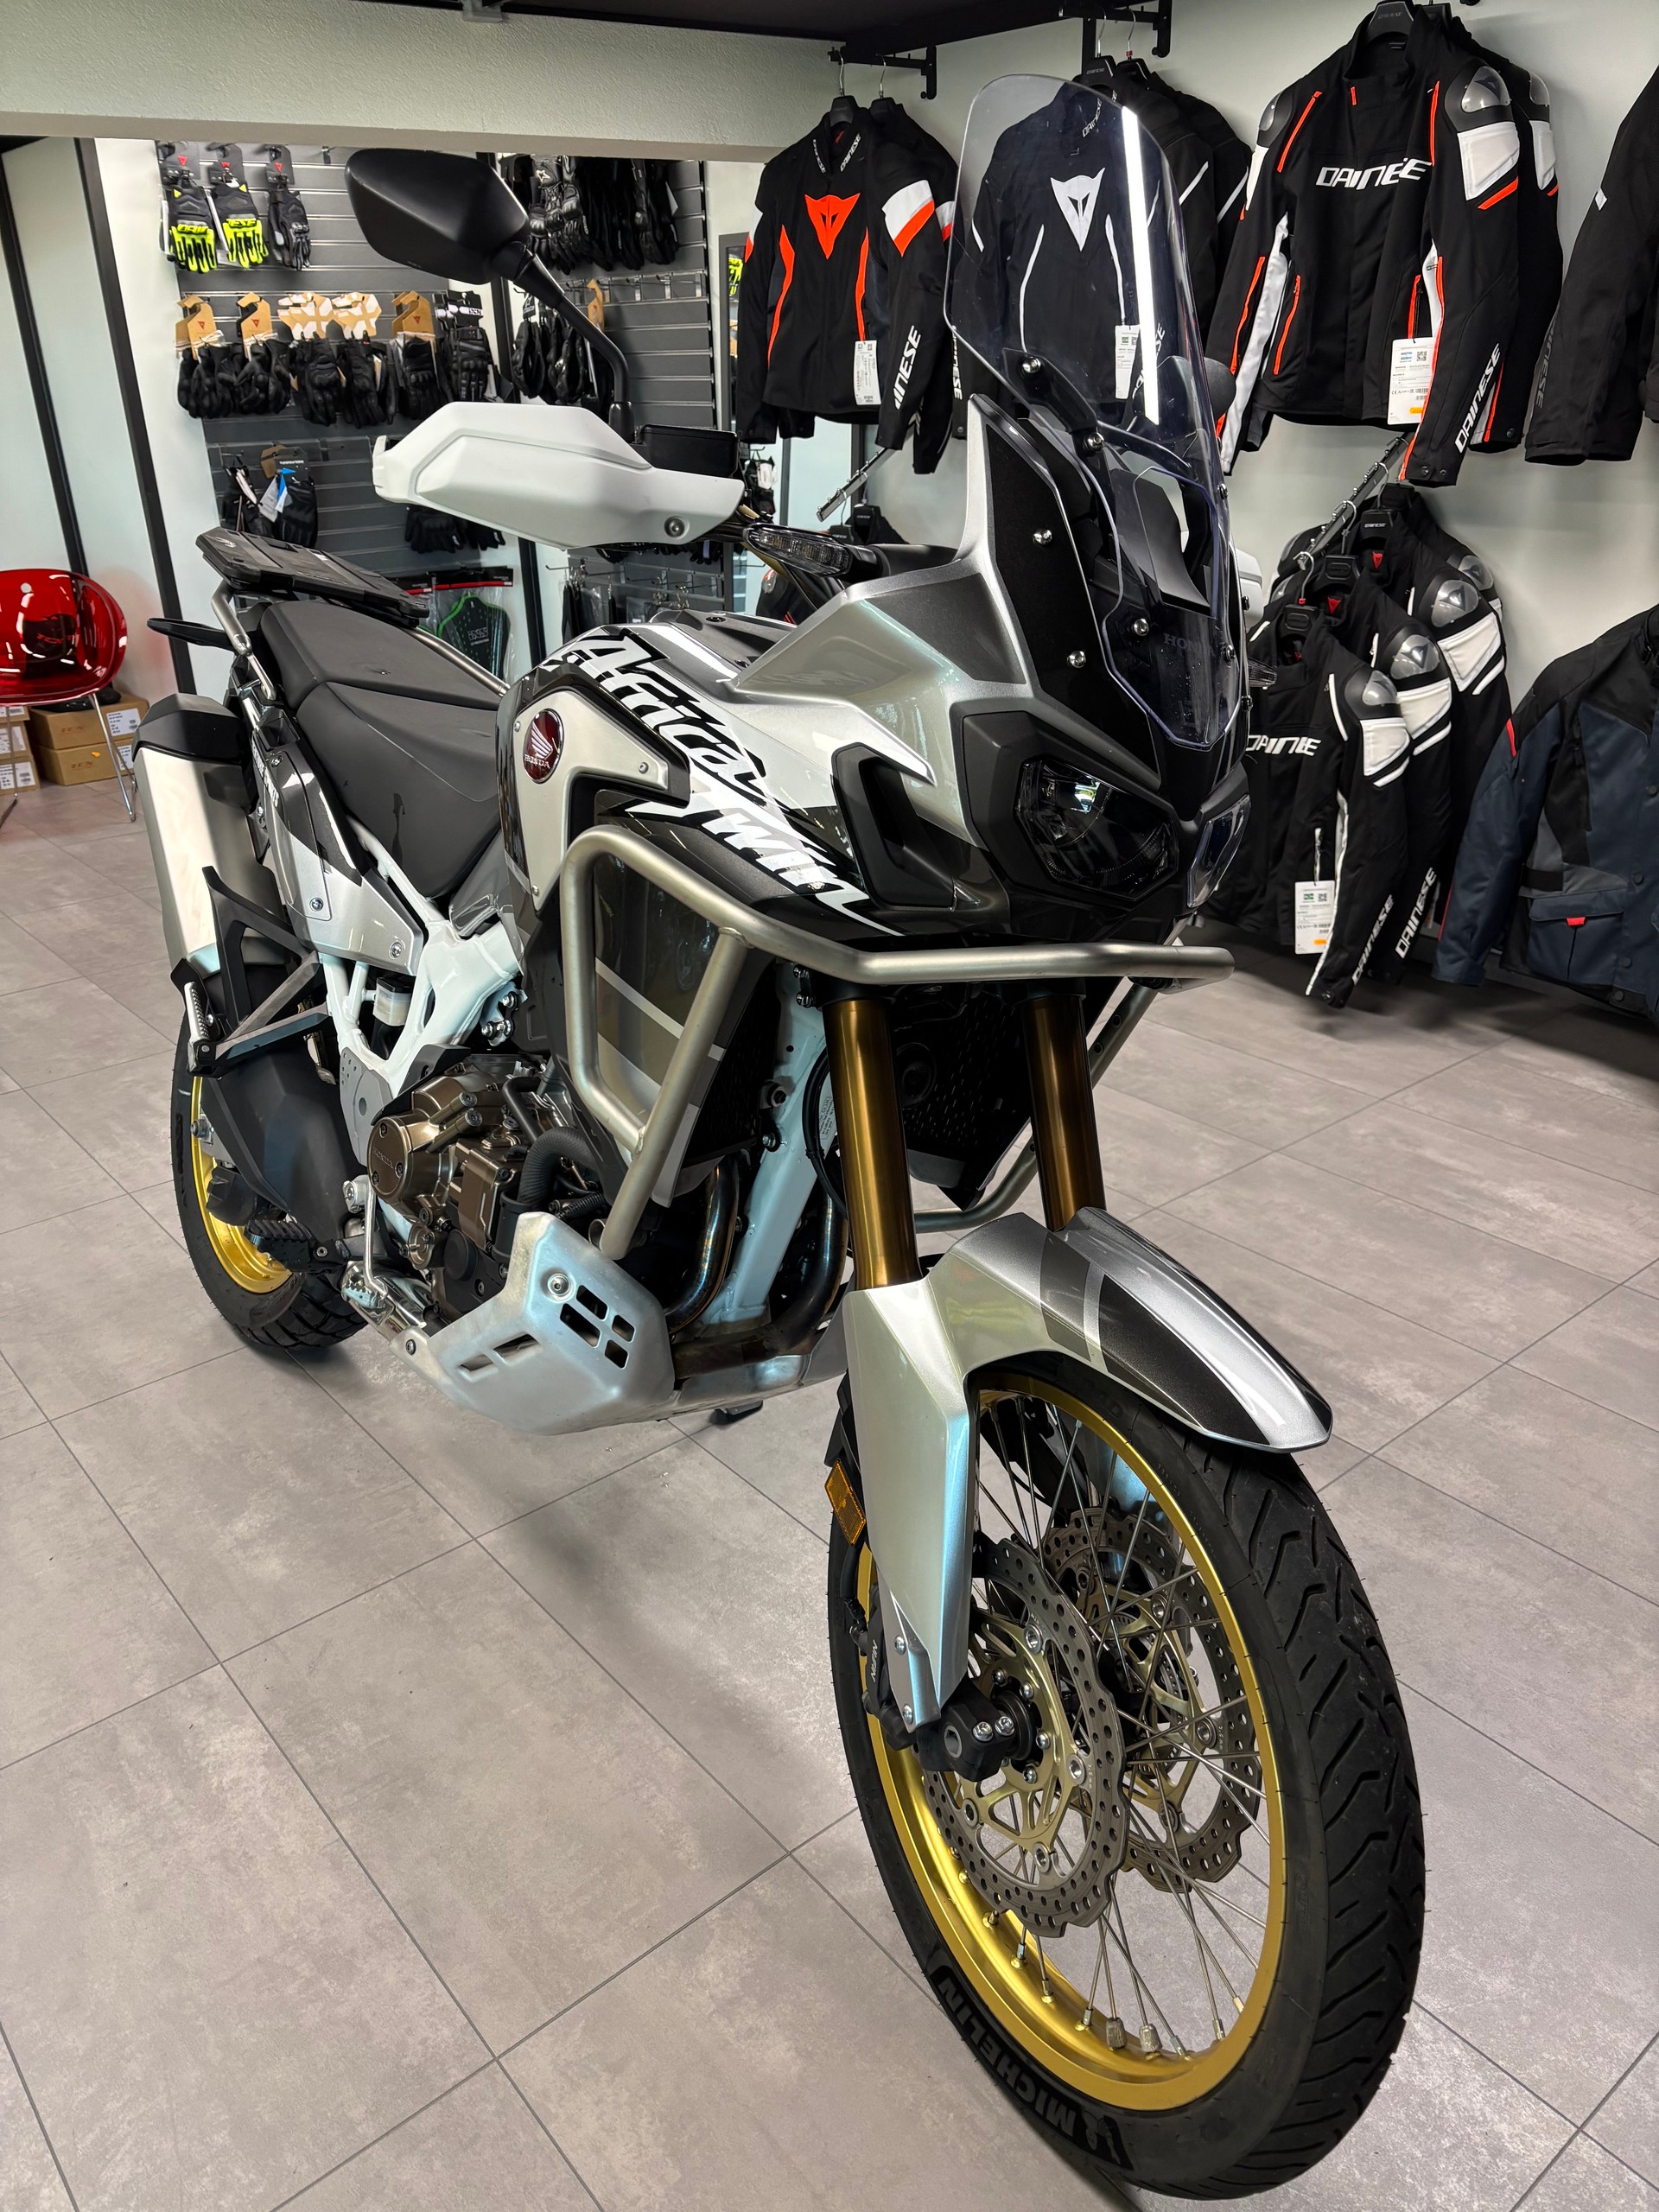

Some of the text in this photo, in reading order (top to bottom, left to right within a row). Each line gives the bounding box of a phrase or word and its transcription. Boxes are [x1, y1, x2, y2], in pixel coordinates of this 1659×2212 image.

[1315, 157, 1433, 191] DAINEE
[1454, 342, 1501, 454] DAINESE
[1163, 632, 1217, 658] HONA
[524, 753, 551, 769] HONDA
[1351, 893, 1395, 987] DAINESE
[1395, 867, 1438, 960] DAINESE
[938, 1977, 1077, 2137] MICHELIN
